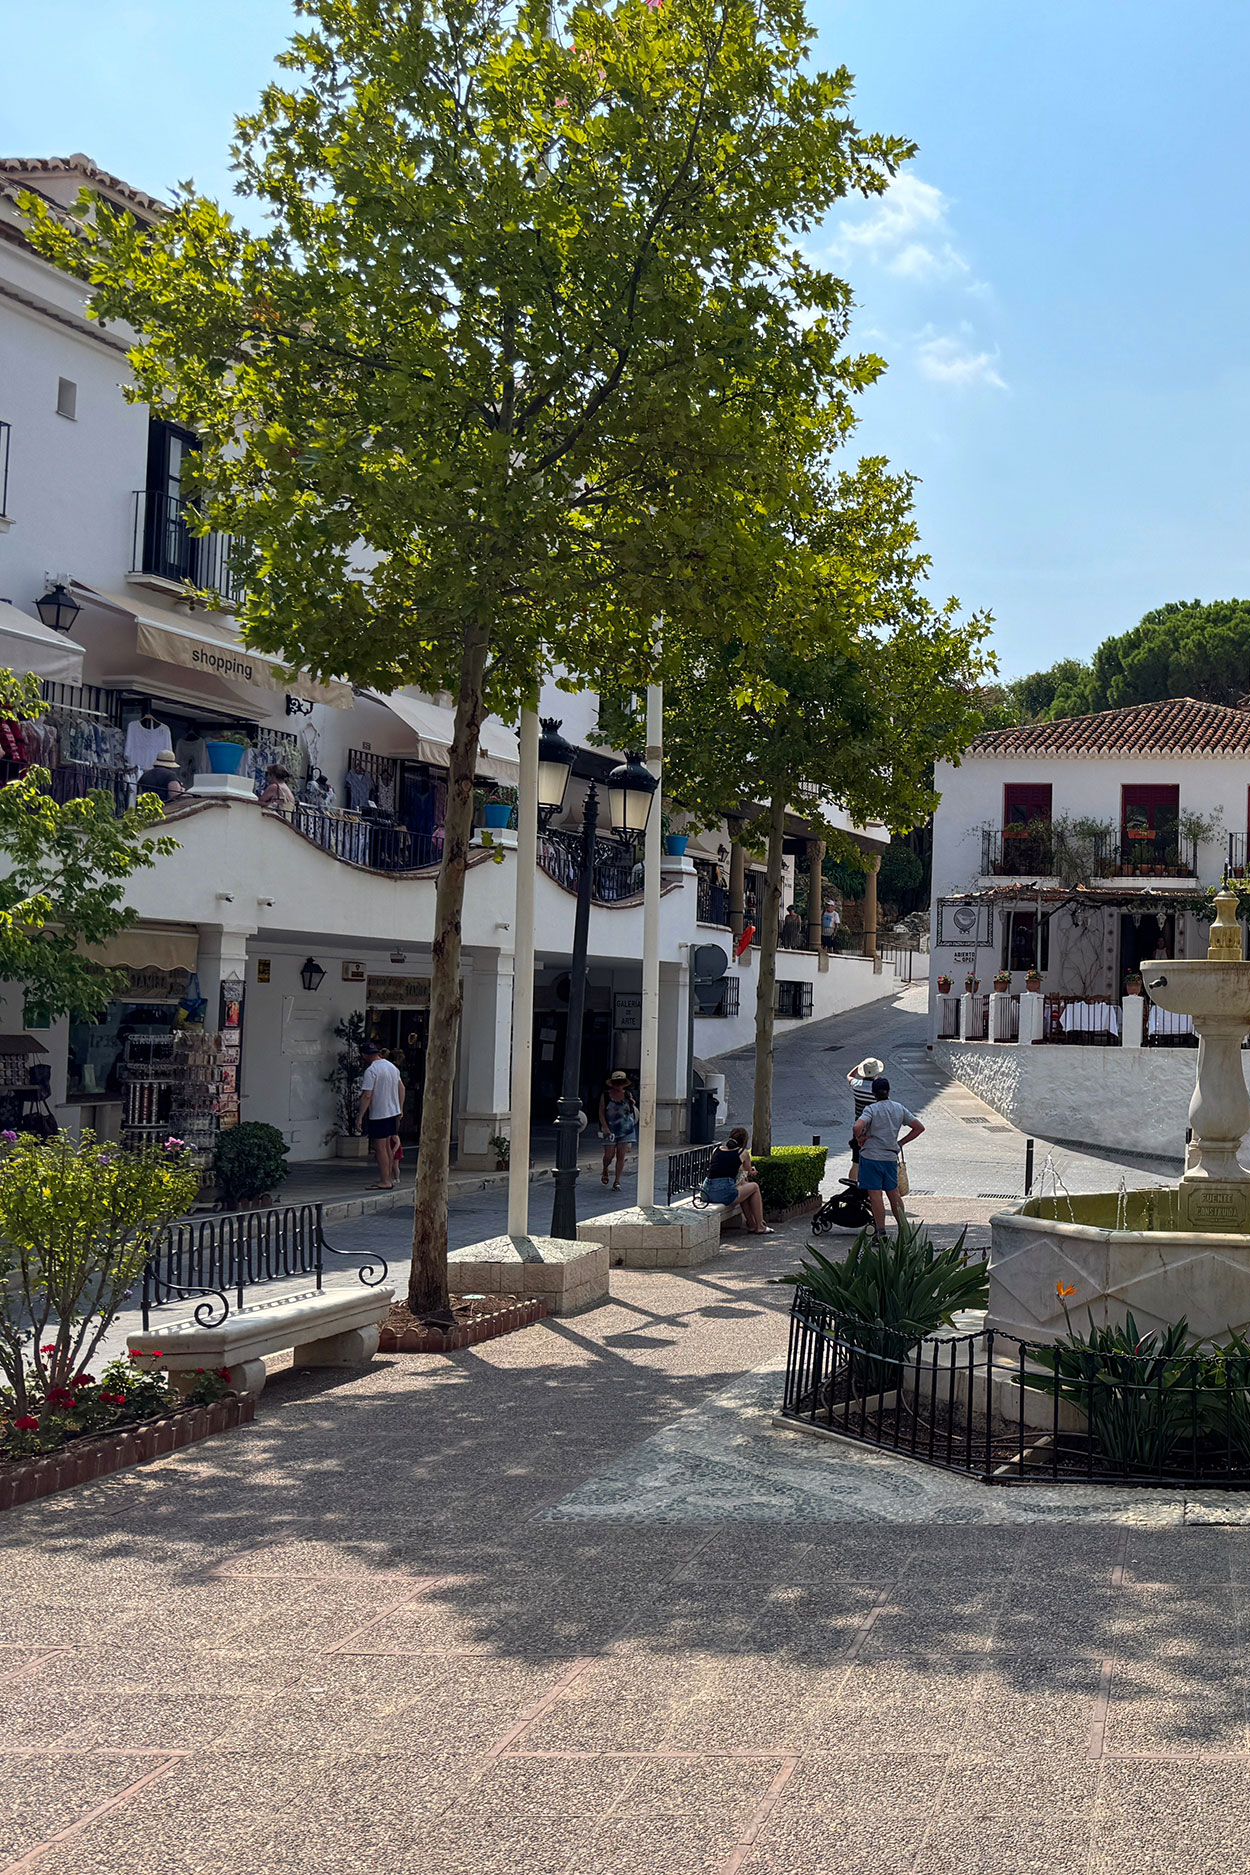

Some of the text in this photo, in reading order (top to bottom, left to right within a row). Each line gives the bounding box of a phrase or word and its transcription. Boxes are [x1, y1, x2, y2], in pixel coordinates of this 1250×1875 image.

[192, 648, 253, 680] shopping
[621, 1017, 636, 1025] ARTE
[1202, 1193, 1233, 1203] FUENTE
[1197, 1206, 1238, 1216] CONSTRUIDA
